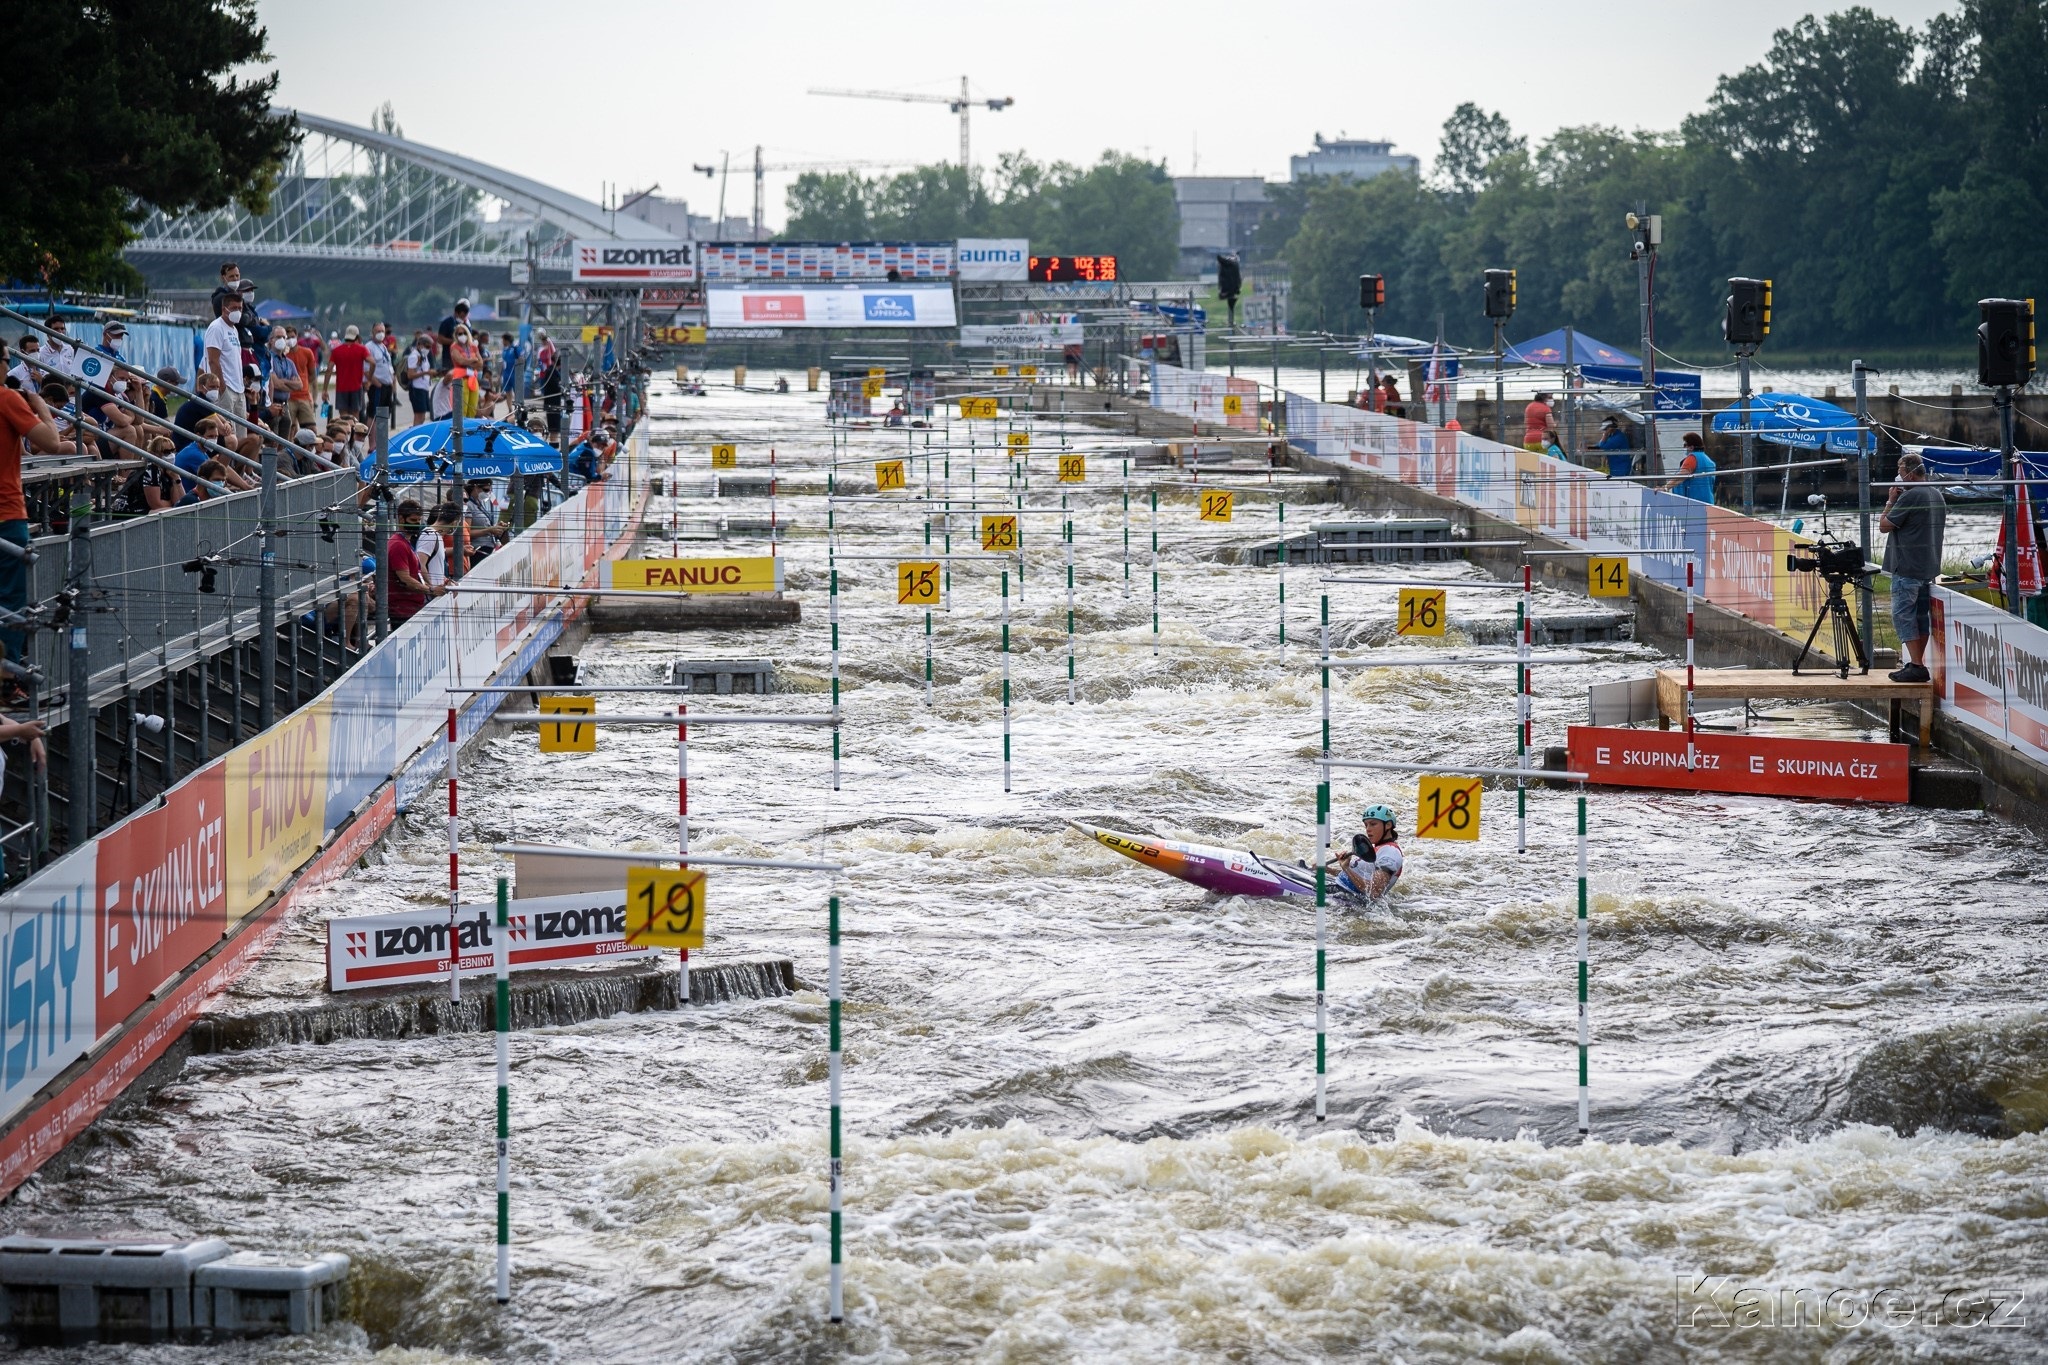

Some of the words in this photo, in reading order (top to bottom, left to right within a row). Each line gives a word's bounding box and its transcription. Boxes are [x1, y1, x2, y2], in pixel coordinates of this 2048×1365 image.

[603, 245, 692, 265] izomat
[960, 250, 1022, 262] auma
[1030, 258, 1038, 269] P
[1051, 258, 1059, 269] 2
[1074, 258, 1115, 269] 102.55
[1046, 270, 1052, 280] 1
[1229, 400, 1237, 411] 4
[1788, 432, 1816, 442] UNIQA
[720, 448, 729, 465] 9
[467, 466, 502, 475] UNIQA
[882, 464, 900, 485] 11
[1064, 460, 1081, 477] 10
[1206, 496, 1228, 517] 12
[987, 522, 1013, 547] 13
[645, 565, 742, 586] FANUC
[1593, 562, 1623, 589] 14
[1722, 537, 1755, 594] SKUPINA
[1754, 536, 1773, 601] ČEZ
[904, 569, 935, 598] 15
[1404, 597, 1438, 628] 16
[552, 707, 589, 743] 17
[1622, 750, 1687, 768] SKUPINA
[1692, 749, 1720, 770] ČEZ
[1777, 759, 1844, 777] SKUPINA
[1849, 758, 1878, 779] ČEZ
[247, 714, 318, 859] FANUC
[1427, 787, 1470, 830] 18
[1244, 866, 1269, 877] triglav
[131, 837, 195, 966] SKUPINA
[198, 799, 223, 910] ČEZ
[638, 879, 694, 935] 19
[375, 911, 493, 956] izomat
[535, 905, 627, 941] izoma
[438, 955, 493, 971] STEBNINY
